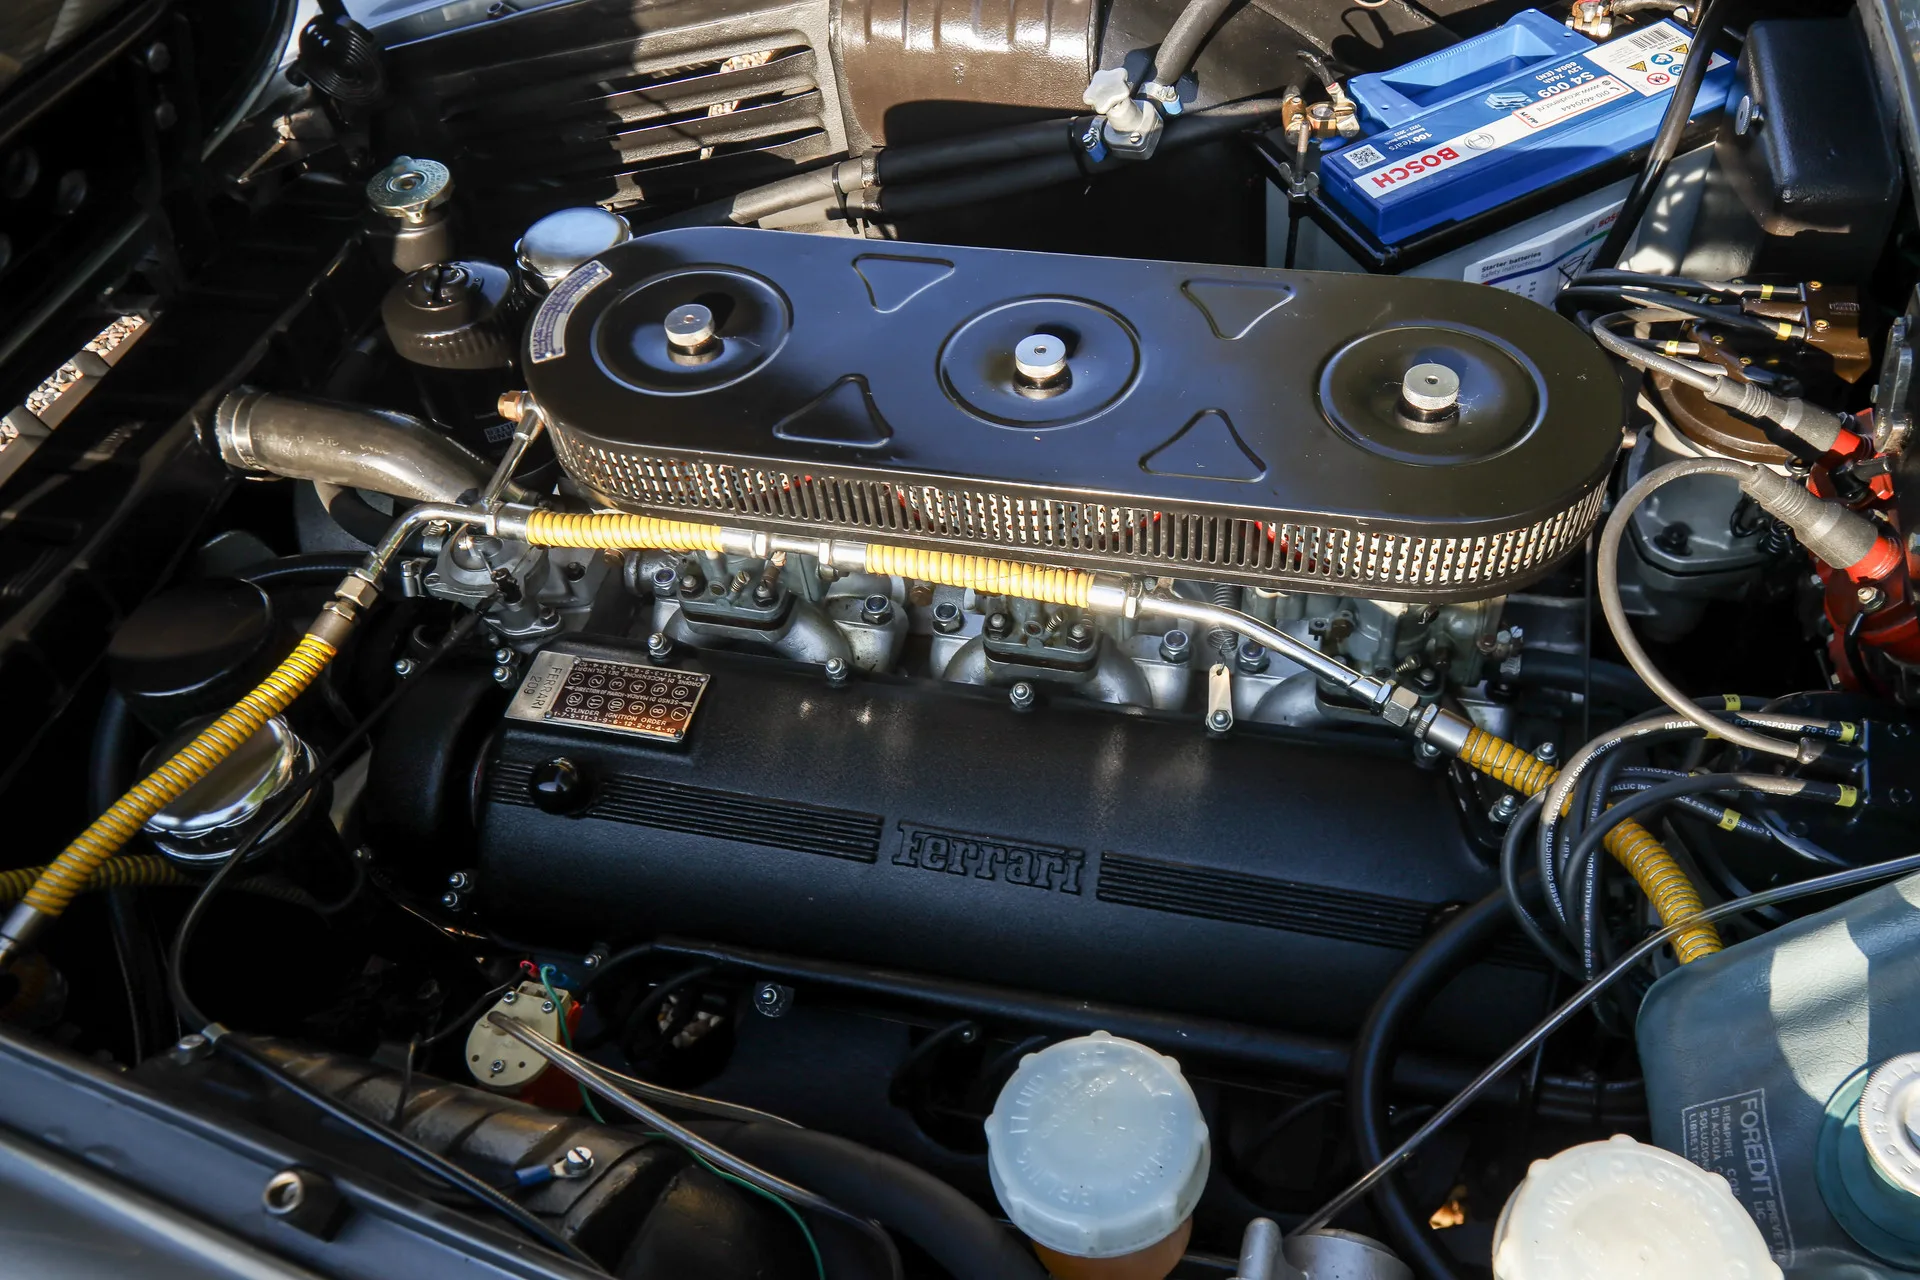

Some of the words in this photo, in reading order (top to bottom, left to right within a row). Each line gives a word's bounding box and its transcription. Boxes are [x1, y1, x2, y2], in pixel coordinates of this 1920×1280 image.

[1535, 70, 1555, 81] (EN)
[1554, 61, 1577, 73] 680A
[1567, 65, 1584, 75] 12V
[1542, 73, 1566, 84] 74Ah
[1570, 71, 1595, 85] S4
[1537, 81, 1571, 98] 009
[1388, 139, 1413, 151] Years
[1412, 132, 1433, 143] 100
[1371, 147, 1460, 188] BOSCH
[1598, 211, 1621, 228] BOS
[1481, 260, 1507, 273] Starter
[1508, 251, 1542, 266] batteries
[486, 422, 514, 436] ILTER
[523, 675, 542, 695] 209
[531, 666, 563, 710] FERRARI
[574, 686, 600, 694] DIRECTION
[677, 680, 702, 688] ORDINE
[657, 697, 680, 705] SENSO
[565, 706, 600, 716] CYLINDER
[604, 713, 637, 722] IGNITION
[640, 716, 667, 726] ORDER
[1664, 720, 1700, 730] MAGN
[1825, 728, 1842, 737] IGN
[1545, 831, 1554, 881] CONDUCTOR
[1550, 811, 1559, 826] ALL
[1556, 776, 1575, 810] SILICONE
[1572, 737, 1622, 777] CONSTRUCTION
[891, 818, 1086, 897] Ferrari
[1584, 880, 1593, 921] METALLIC
[1711, 1107, 1720, 1119] DI
[1722, 1105, 1734, 1158] RIEMPIRE
[1700, 1110, 1711, 1173] SOLUZION
[1711, 1122, 1721, 1162] ACQUA
[1740, 1098, 1775, 1197] FOREDIT
